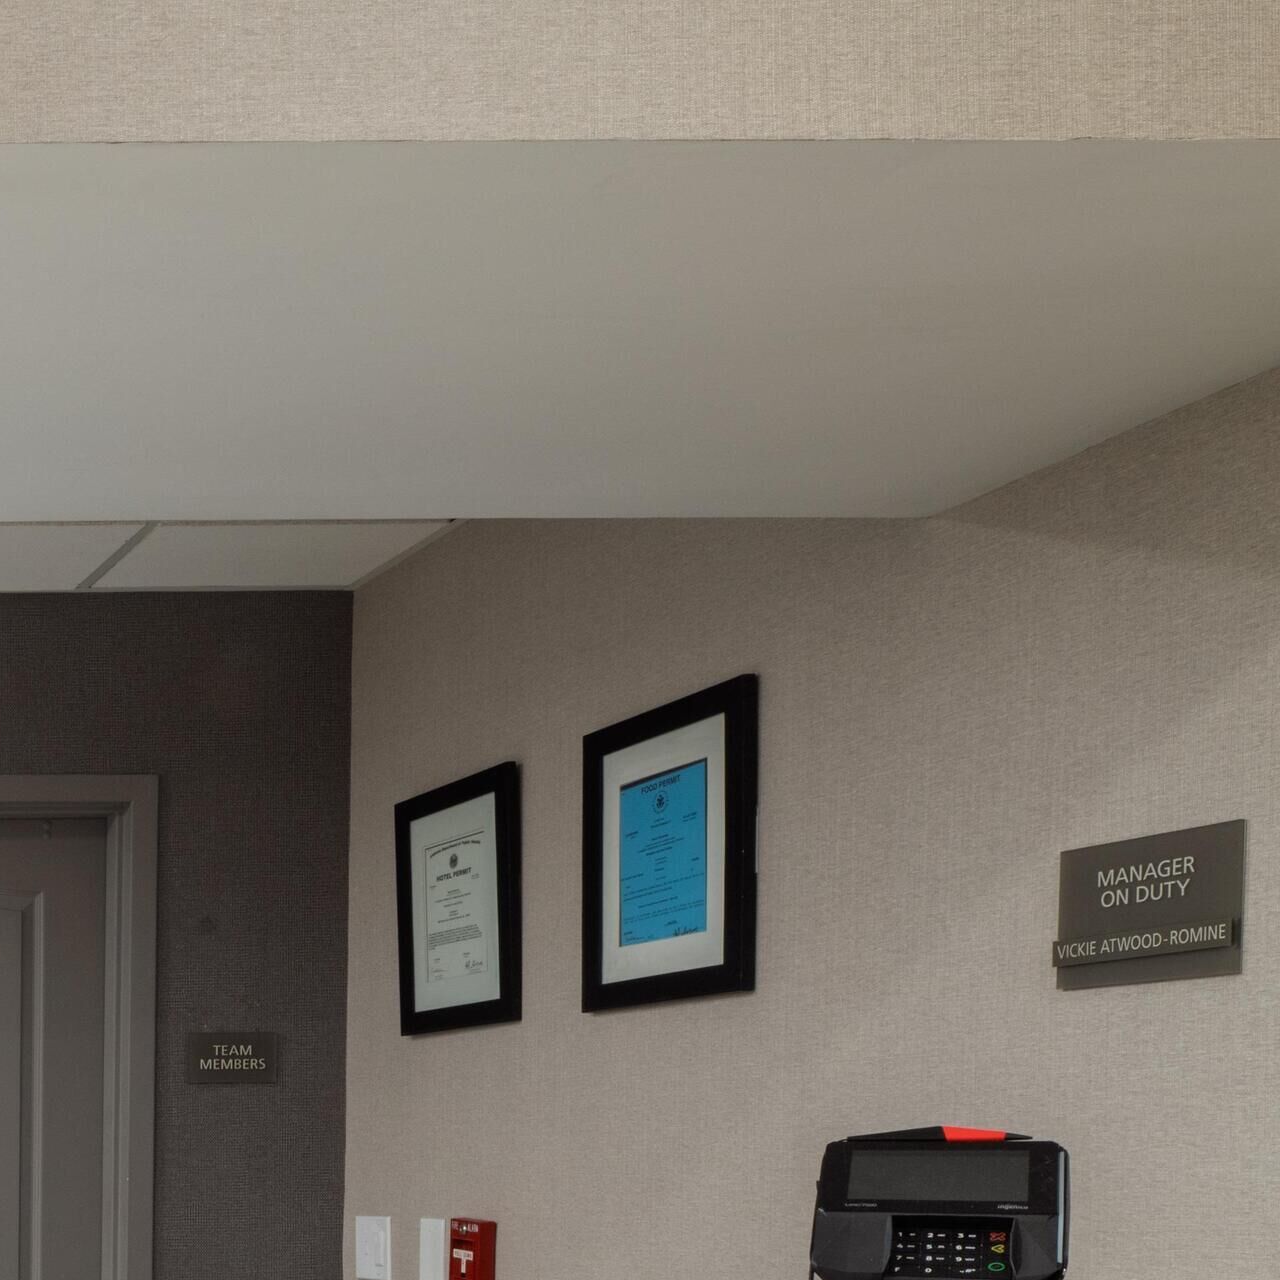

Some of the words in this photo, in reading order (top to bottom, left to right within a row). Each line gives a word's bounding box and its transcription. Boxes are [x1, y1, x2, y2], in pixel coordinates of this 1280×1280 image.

[641, 784, 658, 794] FOOD
[659, 774, 681, 788] PERMIT
[453, 867, 472, 878] PERMIT
[1097, 856, 1195, 888] MANAGER
[1101, 888, 1129, 908] ON
[1136, 879, 1190, 903] DUTY
[1057, 941, 1097, 960] VICKIE
[1100, 923, 1226, 954] ATWOOD-ROMINE
[213, 1044, 253, 1056] TEAM
[199, 1057, 266, 1071] MEMBERS
